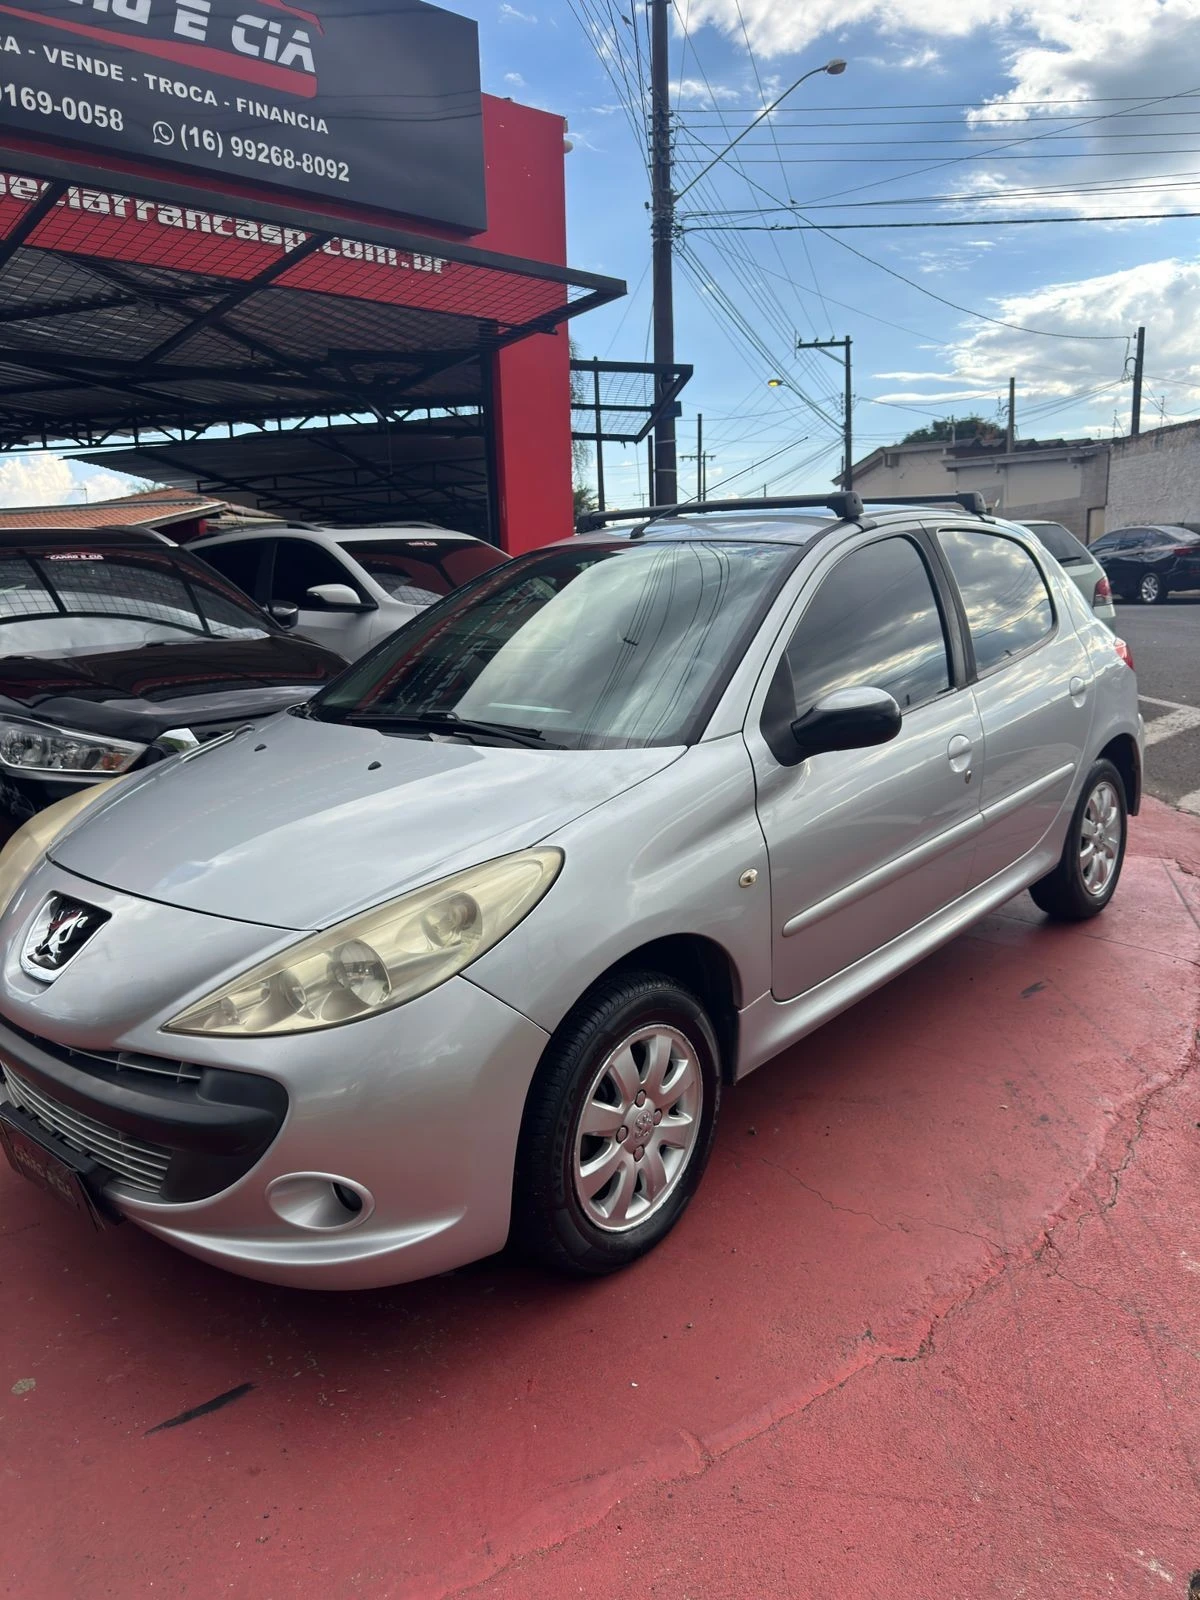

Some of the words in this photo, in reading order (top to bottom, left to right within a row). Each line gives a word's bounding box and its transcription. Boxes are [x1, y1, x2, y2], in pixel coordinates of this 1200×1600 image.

[174, 0, 211, 41] E
[0, 35, 22, 55] A
[43, 44, 124, 82] VENDE
[144, 73, 218, 107] TROCA
[236, 98, 329, 135] FINANCIA
[0, 83, 124, 132] 169-0058
[180, 124, 224, 159] (16)
[230, 136, 350, 183] 99268-8092
